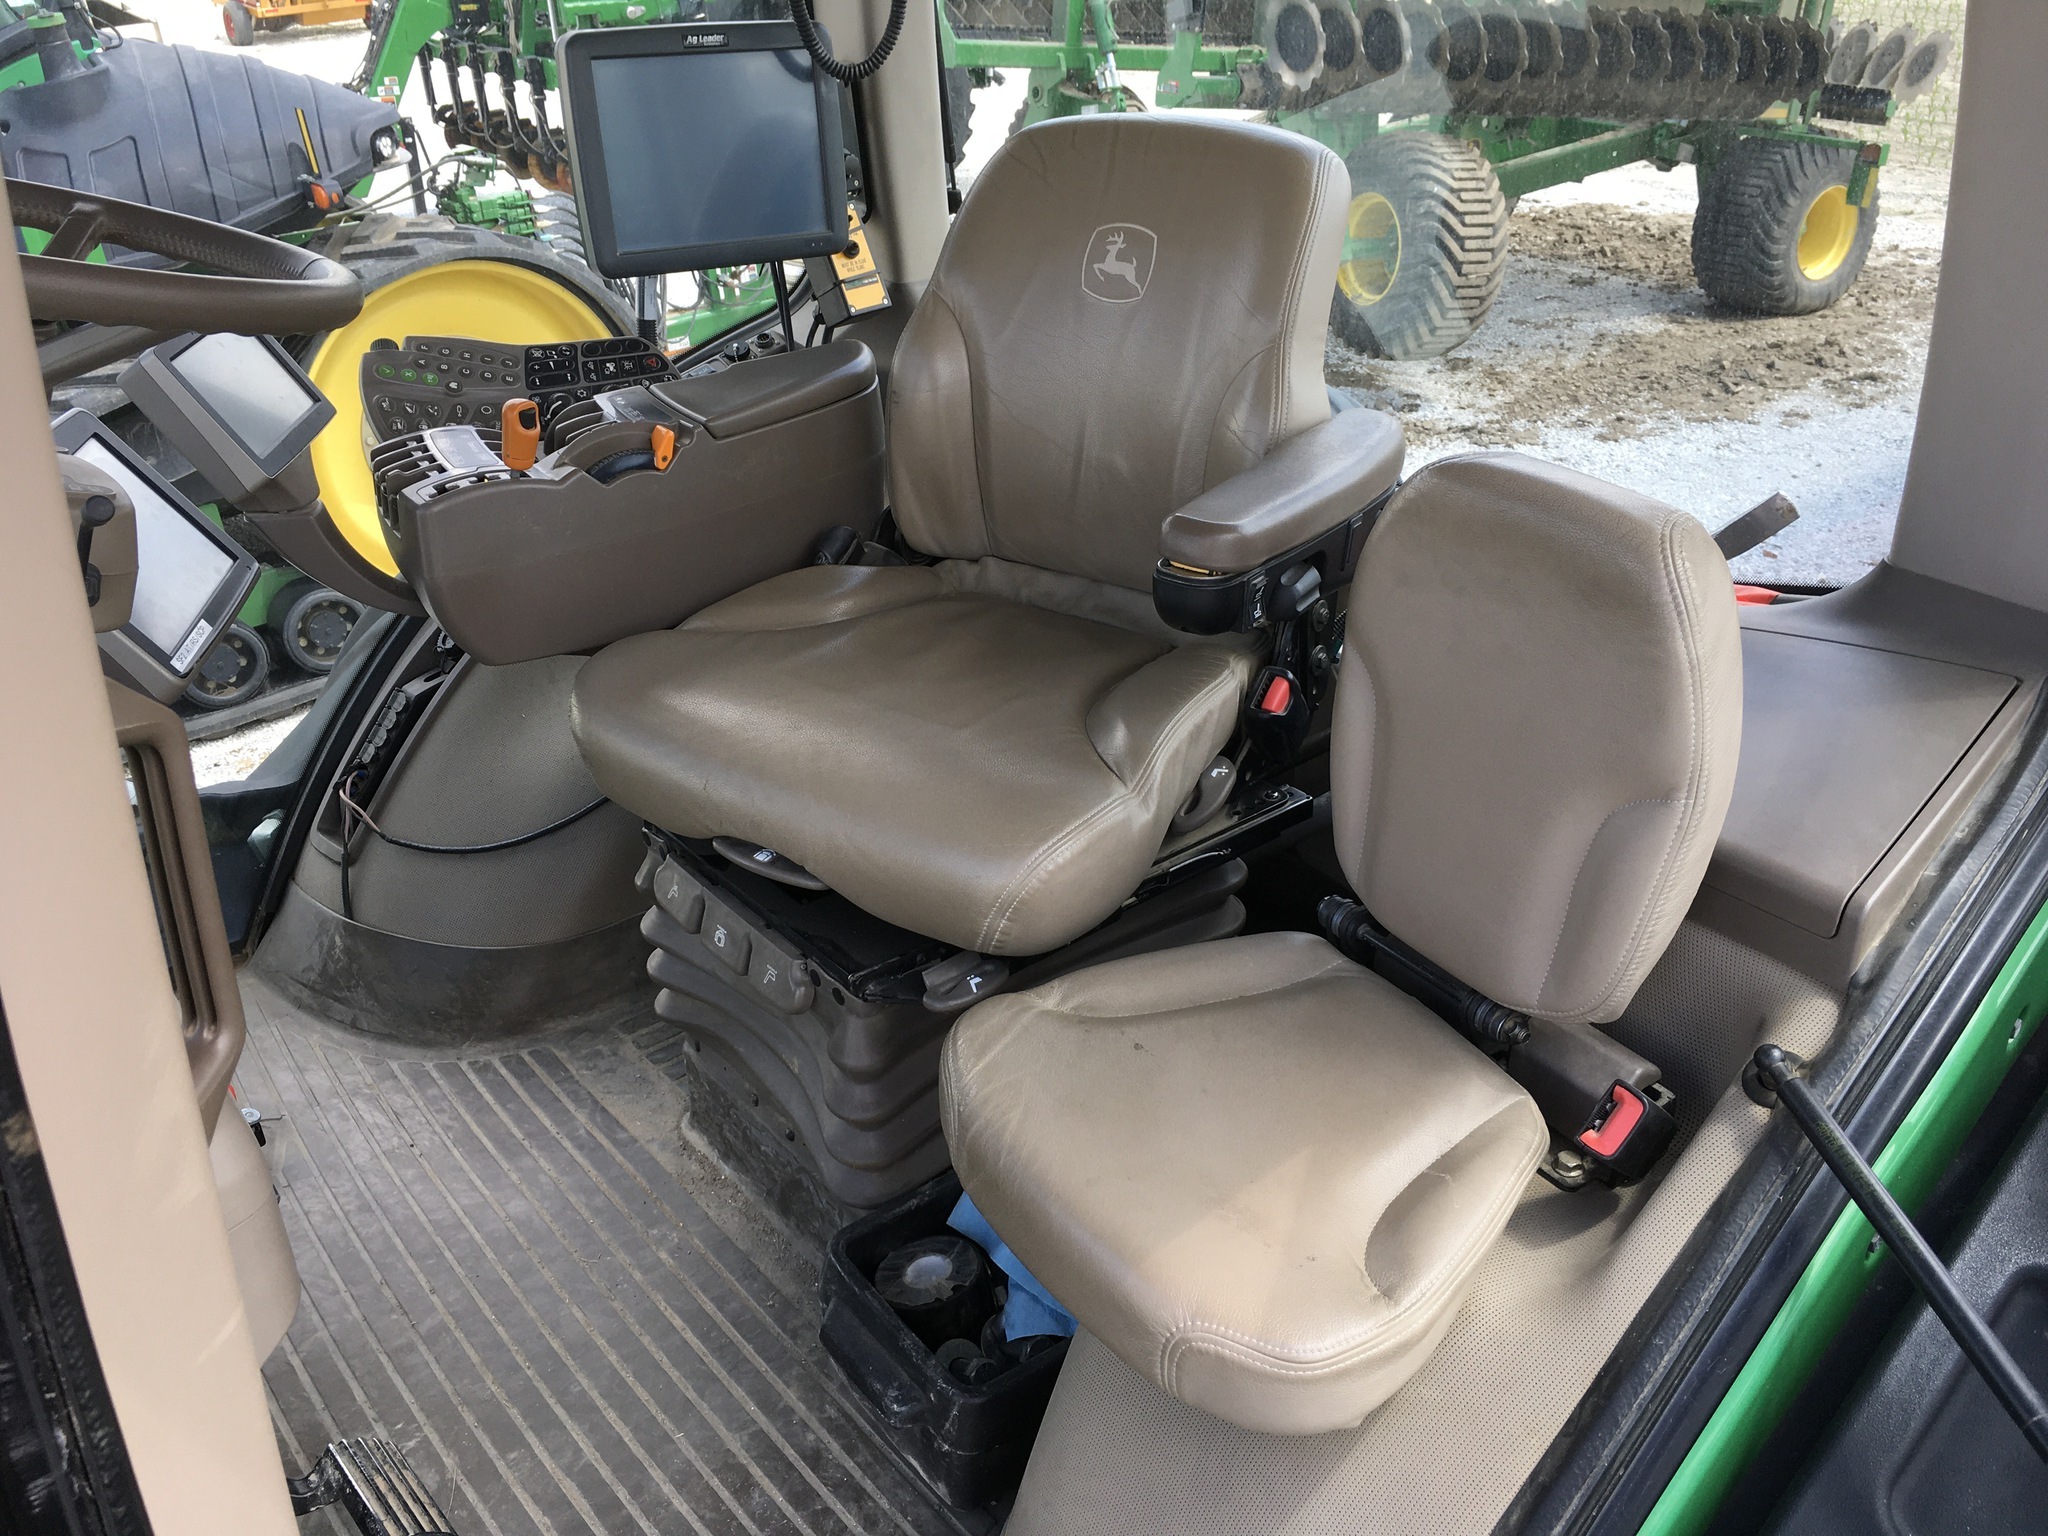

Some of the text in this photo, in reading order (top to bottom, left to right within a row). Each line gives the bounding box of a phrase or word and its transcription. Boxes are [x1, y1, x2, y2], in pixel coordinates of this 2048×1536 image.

[686, 35, 698, 44] Ag
[699, 33, 724, 42] Leader
[175, 652, 188, 665] SF2
